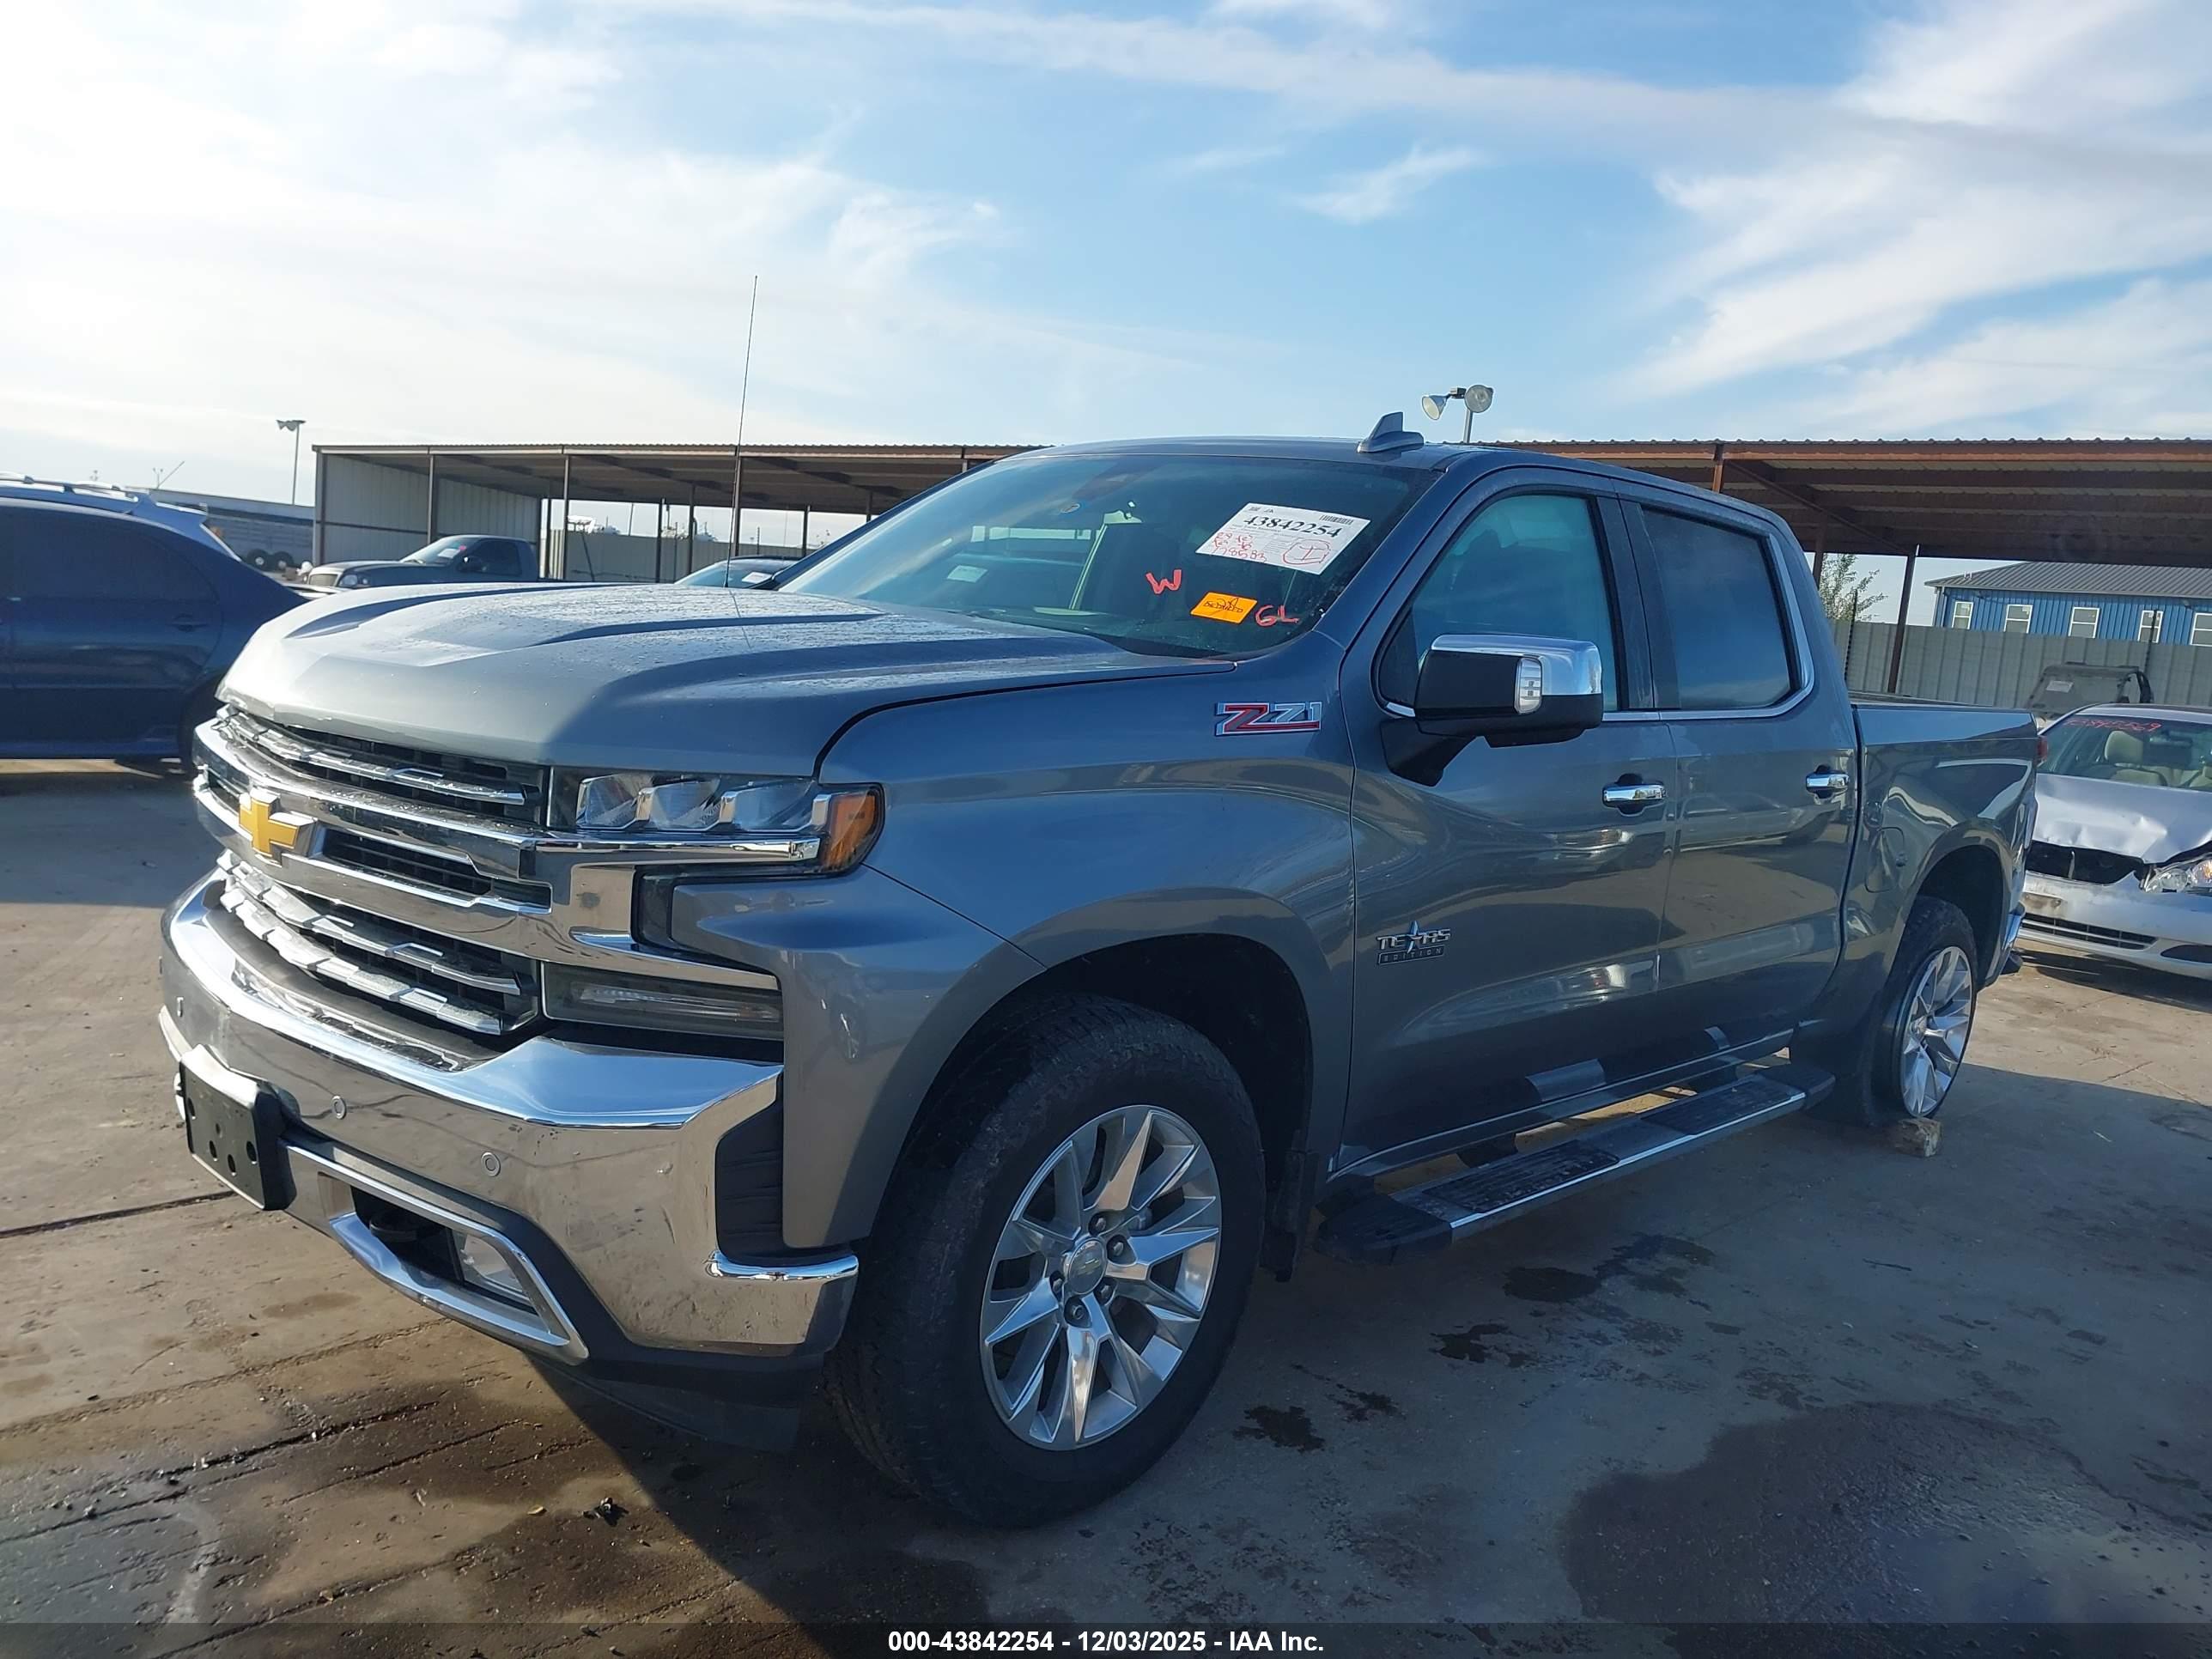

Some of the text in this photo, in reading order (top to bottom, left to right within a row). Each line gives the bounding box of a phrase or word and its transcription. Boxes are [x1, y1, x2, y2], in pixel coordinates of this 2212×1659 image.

[1244, 515, 1342, 538] 43842254
[1146, 569, 1182, 594] W
[1216, 702, 1322, 735] Z71
[1376, 924, 1451, 951] TEXAS
[1383, 947, 1442, 962] EDITION
